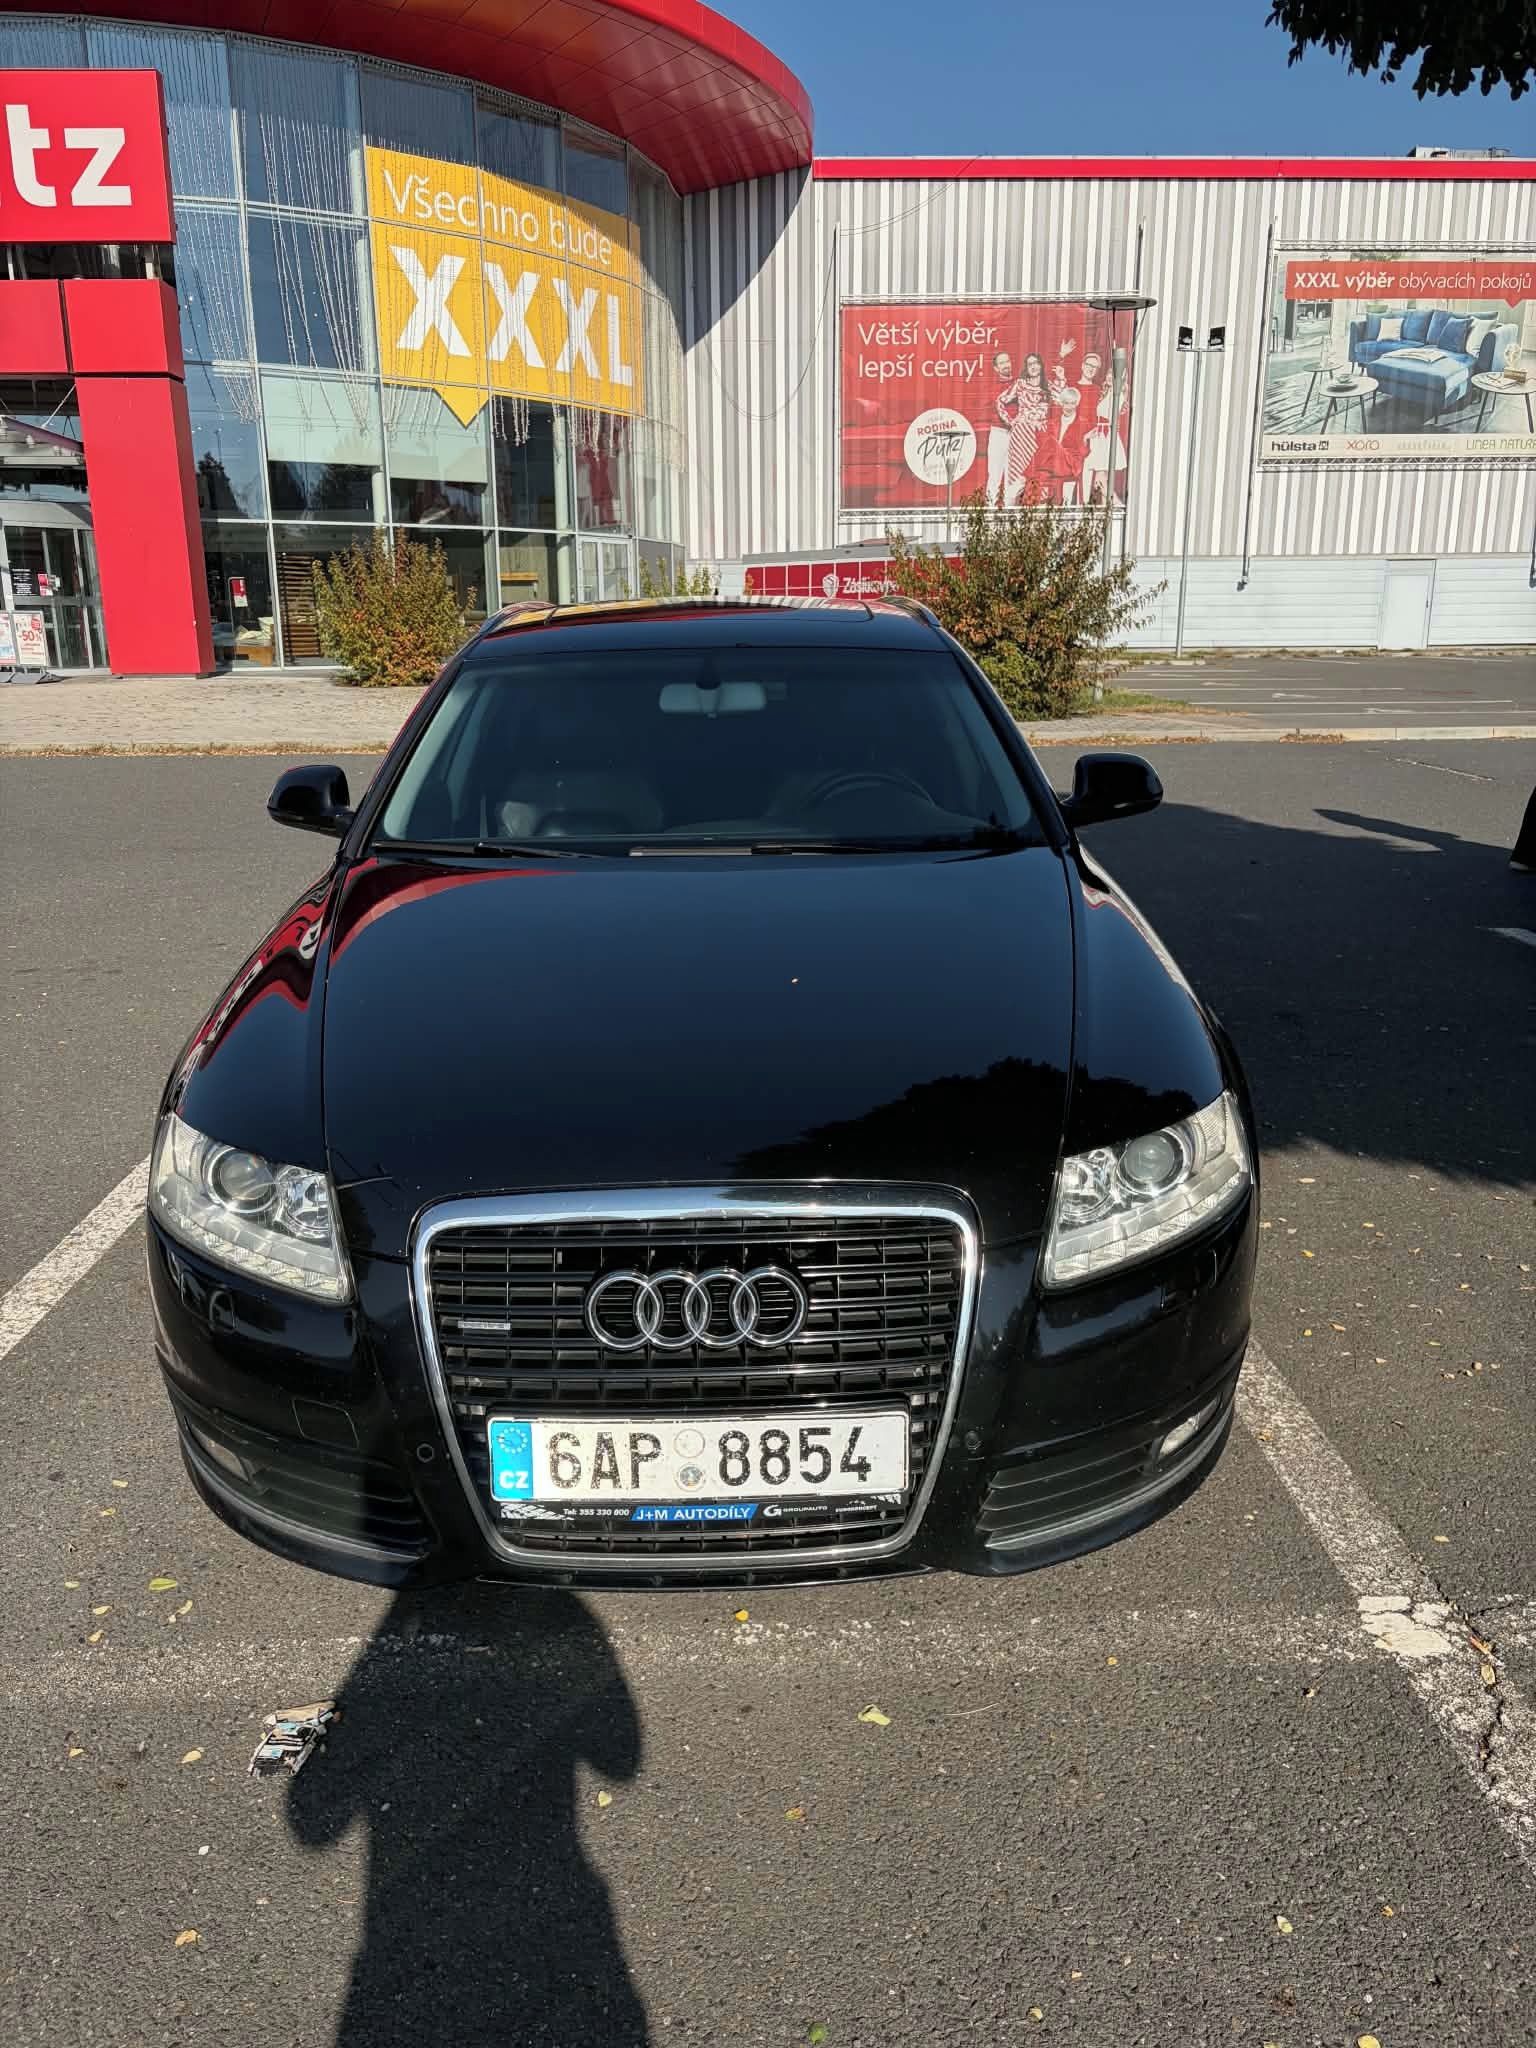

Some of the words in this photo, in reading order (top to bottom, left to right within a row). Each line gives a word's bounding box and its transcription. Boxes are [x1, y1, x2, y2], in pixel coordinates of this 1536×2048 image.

[0, 103, 133, 207] tz
[383, 169, 540, 242] Všechno
[549, 206, 613, 264] bude
[1294, 272, 1340, 288] XXXL
[1345, 271, 1394, 293] výběr
[1400, 272, 1476, 293] obývacích
[1480, 273, 1532, 293] pokojů
[389, 245, 633, 386] XXXL
[858, 320, 920, 346] Větší
[925, 320, 999, 350] výběr,
[858, 353, 914, 383] lepší
[921, 353, 985, 383] ceny!
[917, 419, 958, 437] RODINA
[1271, 440, 1317, 451] hülsta
[549, 1430, 662, 1489] 6AP
[718, 1426, 872, 1486] 8854
[500, 1469, 529, 1489] CZ
[637, 1508, 668, 1520] J+M
[674, 1505, 750, 1520] AUTODÍLY
[783, 1504, 828, 1513] GROUPAUTO
